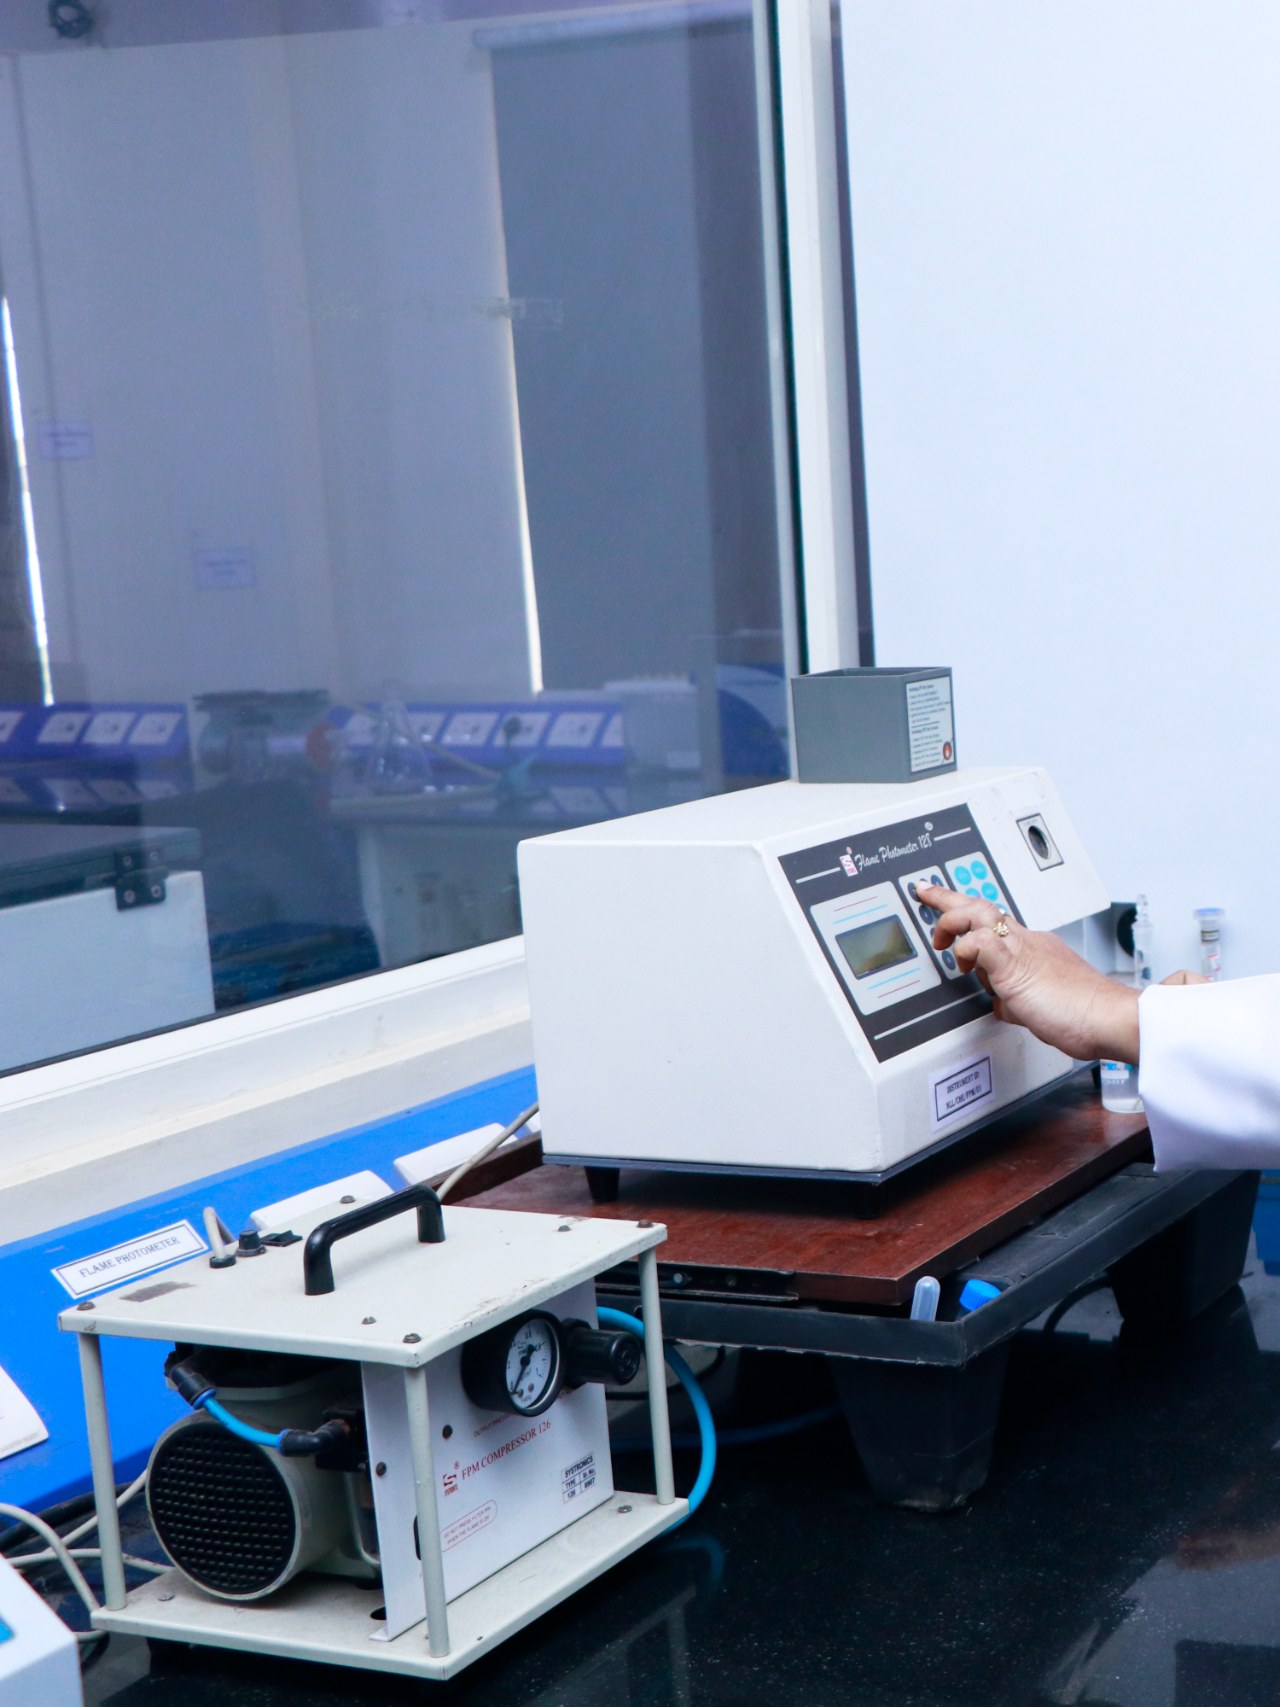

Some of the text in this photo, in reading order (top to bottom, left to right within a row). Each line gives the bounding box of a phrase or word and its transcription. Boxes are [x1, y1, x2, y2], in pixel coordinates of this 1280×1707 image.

[854, 852, 880, 872] Flame
[879, 843, 919, 862] Photometer
[918, 832, 932, 849] 128
[79, 1236, 181, 1278] FLAME PHOTOMETER
[461, 1419, 551, 1480] FPM COMPRESSOR 126
[564, 1455, 593, 1478] SYSTRONICS
[565, 1478, 576, 1489] TYPE
